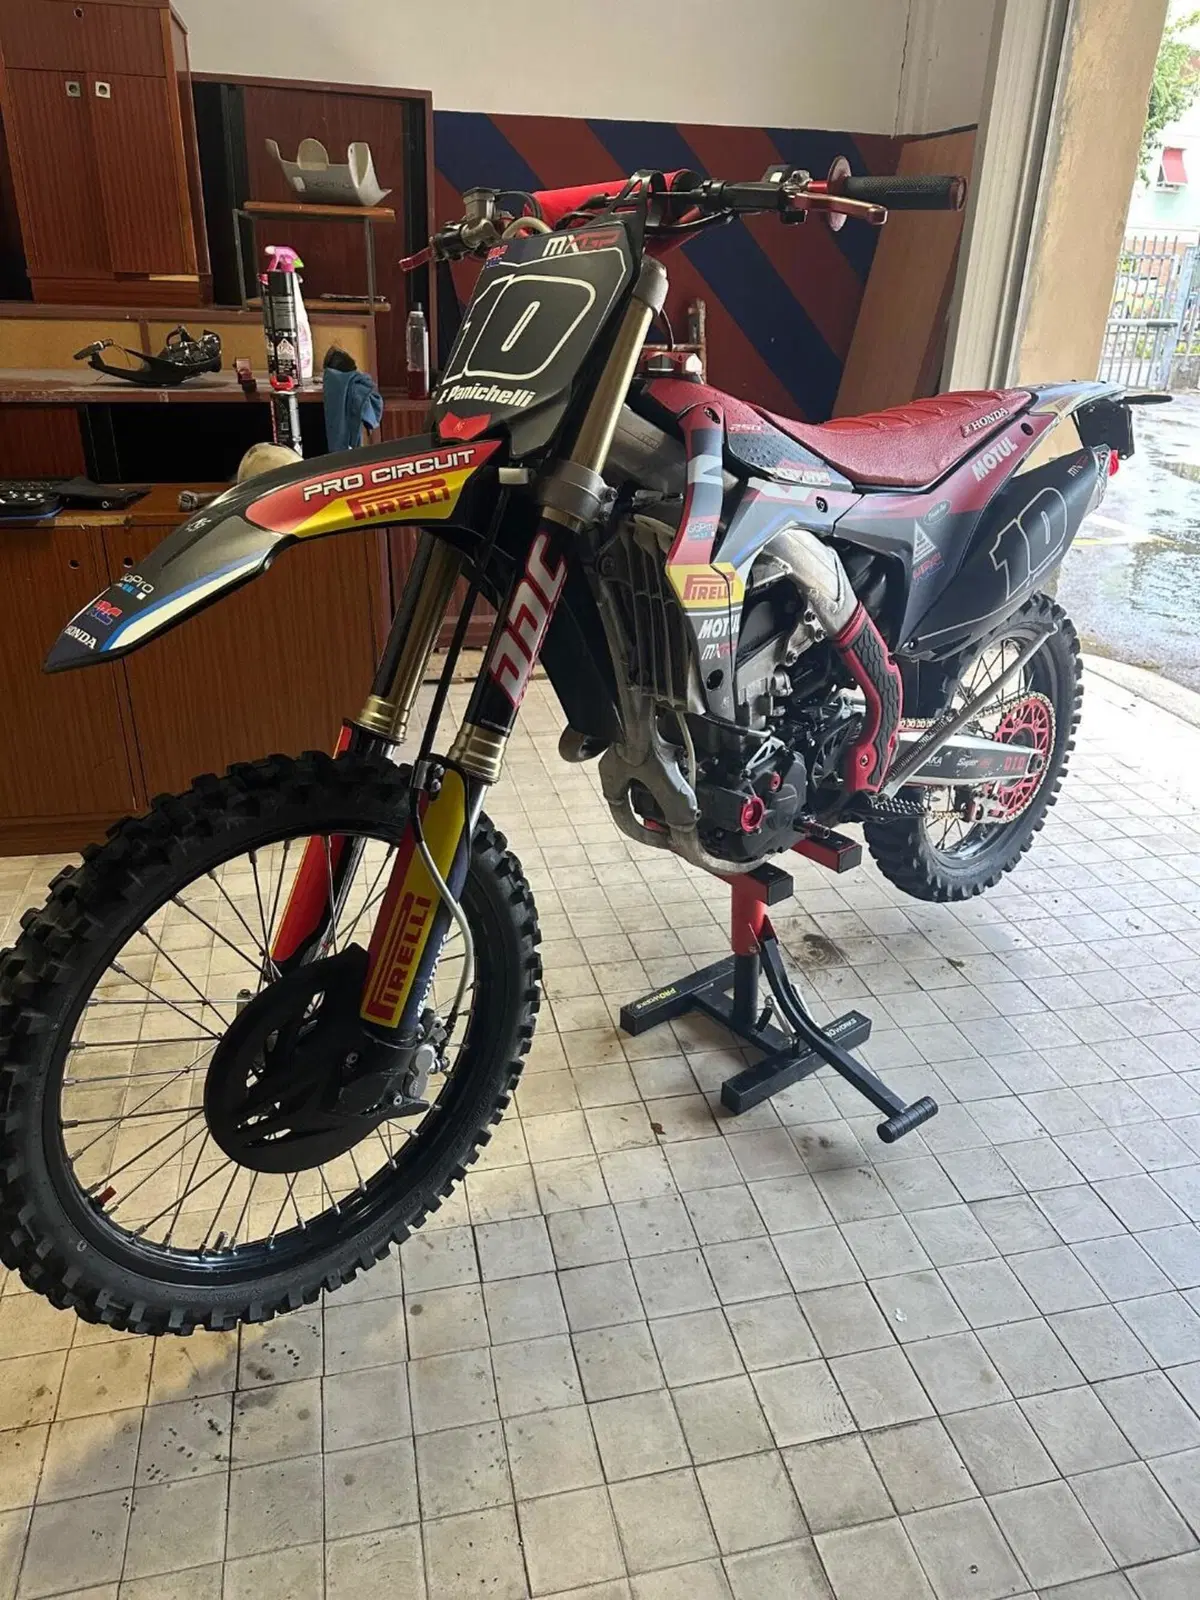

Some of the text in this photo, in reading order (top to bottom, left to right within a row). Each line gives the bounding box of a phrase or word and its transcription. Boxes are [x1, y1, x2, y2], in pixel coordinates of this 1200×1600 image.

[446, 383, 537, 407] Panichelli
[972, 408, 1009, 431] HONDA
[303, 449, 475, 501] PRO CIRCUIT
[971, 437, 1018, 482] MOTUL
[346, 478, 450, 520] PIRELLI
[989, 487, 1068, 601] 10
[682, 571, 736, 601] PIRELLI
[364, 891, 432, 1021] PIRELLI
